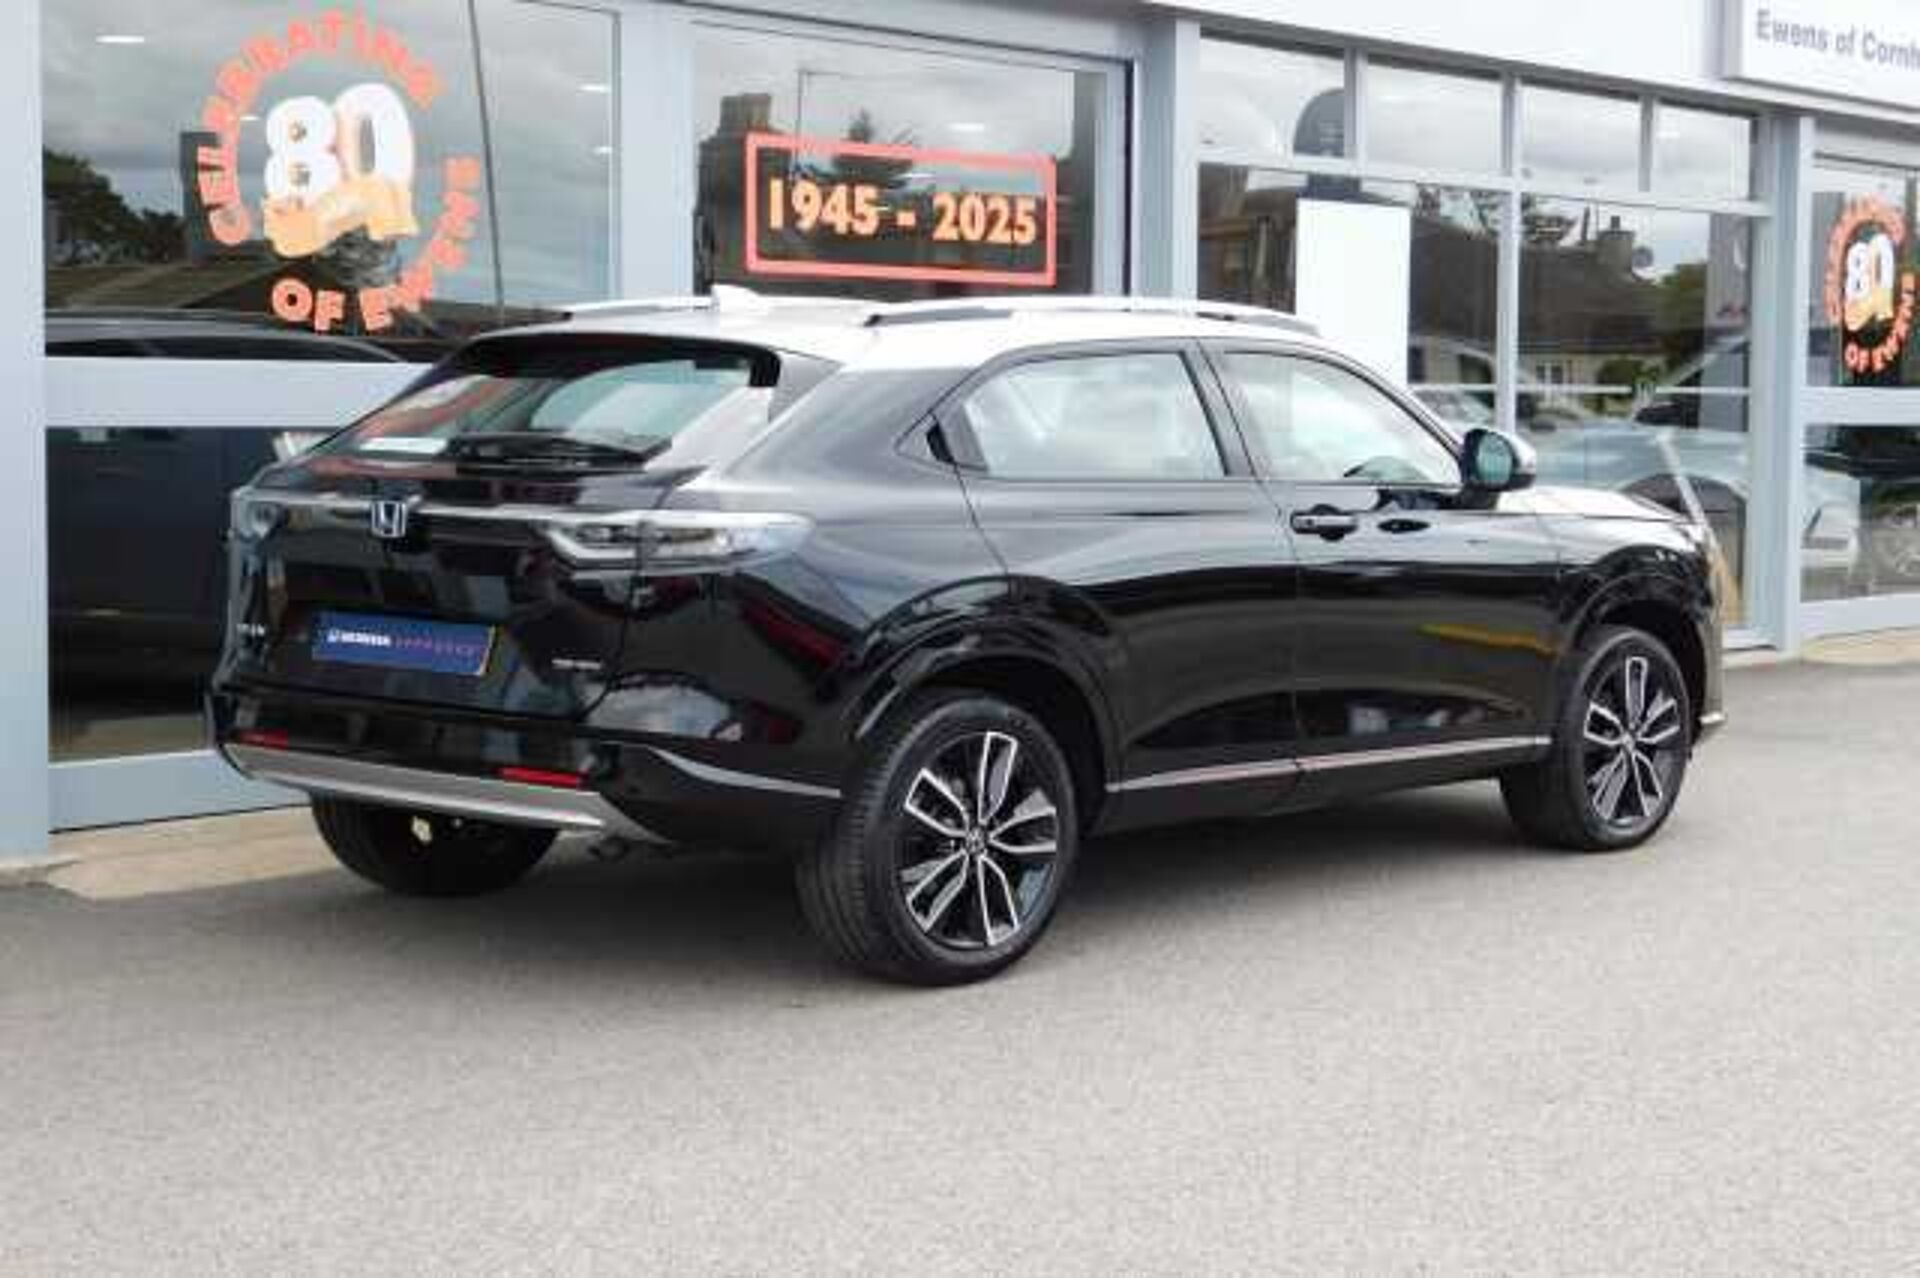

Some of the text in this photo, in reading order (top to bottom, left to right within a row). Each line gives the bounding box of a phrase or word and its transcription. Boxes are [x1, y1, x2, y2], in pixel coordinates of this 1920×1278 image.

[1757, 8, 1828, 51] Ewens
[1836, 27, 1856, 56] of
[263, 82, 416, 204] 80
[768, 178, 1037, 244] 1945 - 2025
[1845, 233, 1894, 298] 80
[271, 278, 346, 332] OF
